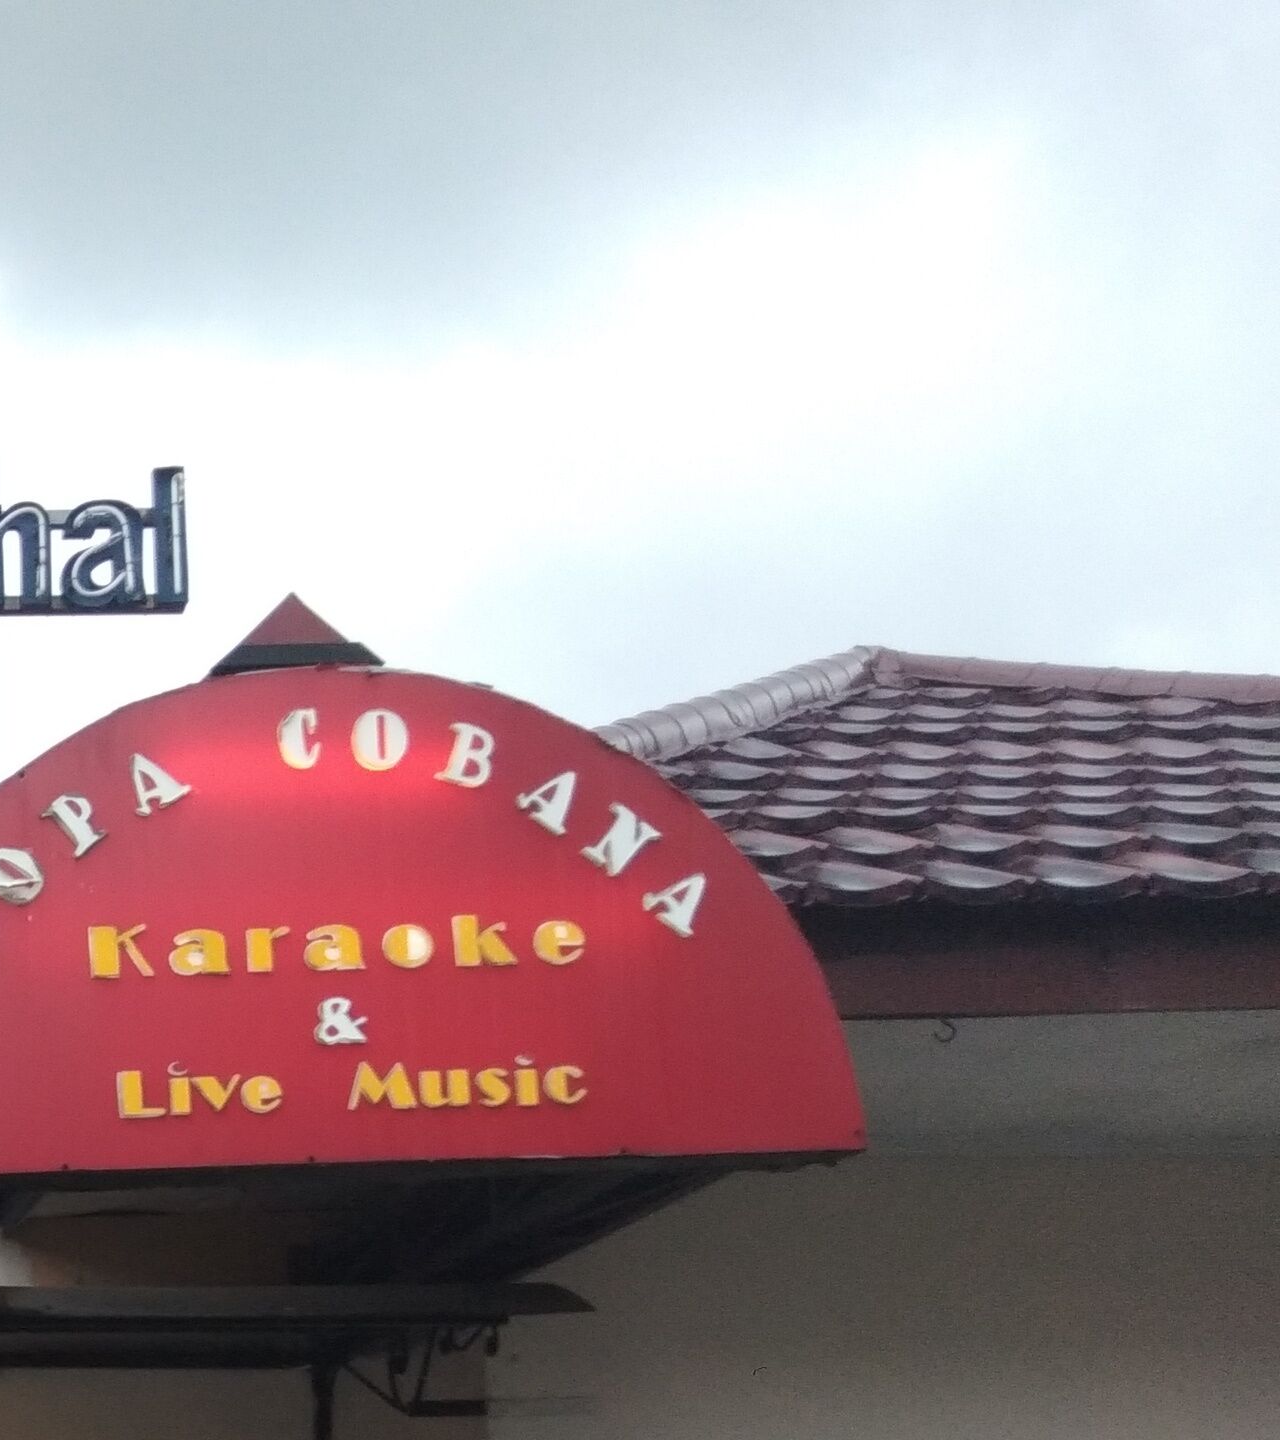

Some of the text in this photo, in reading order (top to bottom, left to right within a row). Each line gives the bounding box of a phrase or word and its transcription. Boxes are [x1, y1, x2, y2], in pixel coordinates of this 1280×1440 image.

[276, 707, 709, 939] COBANA
[86, 912, 587, 980] Karaoke
[313, 995, 368, 1046] &
[115, 1054, 589, 1121] Live Music
